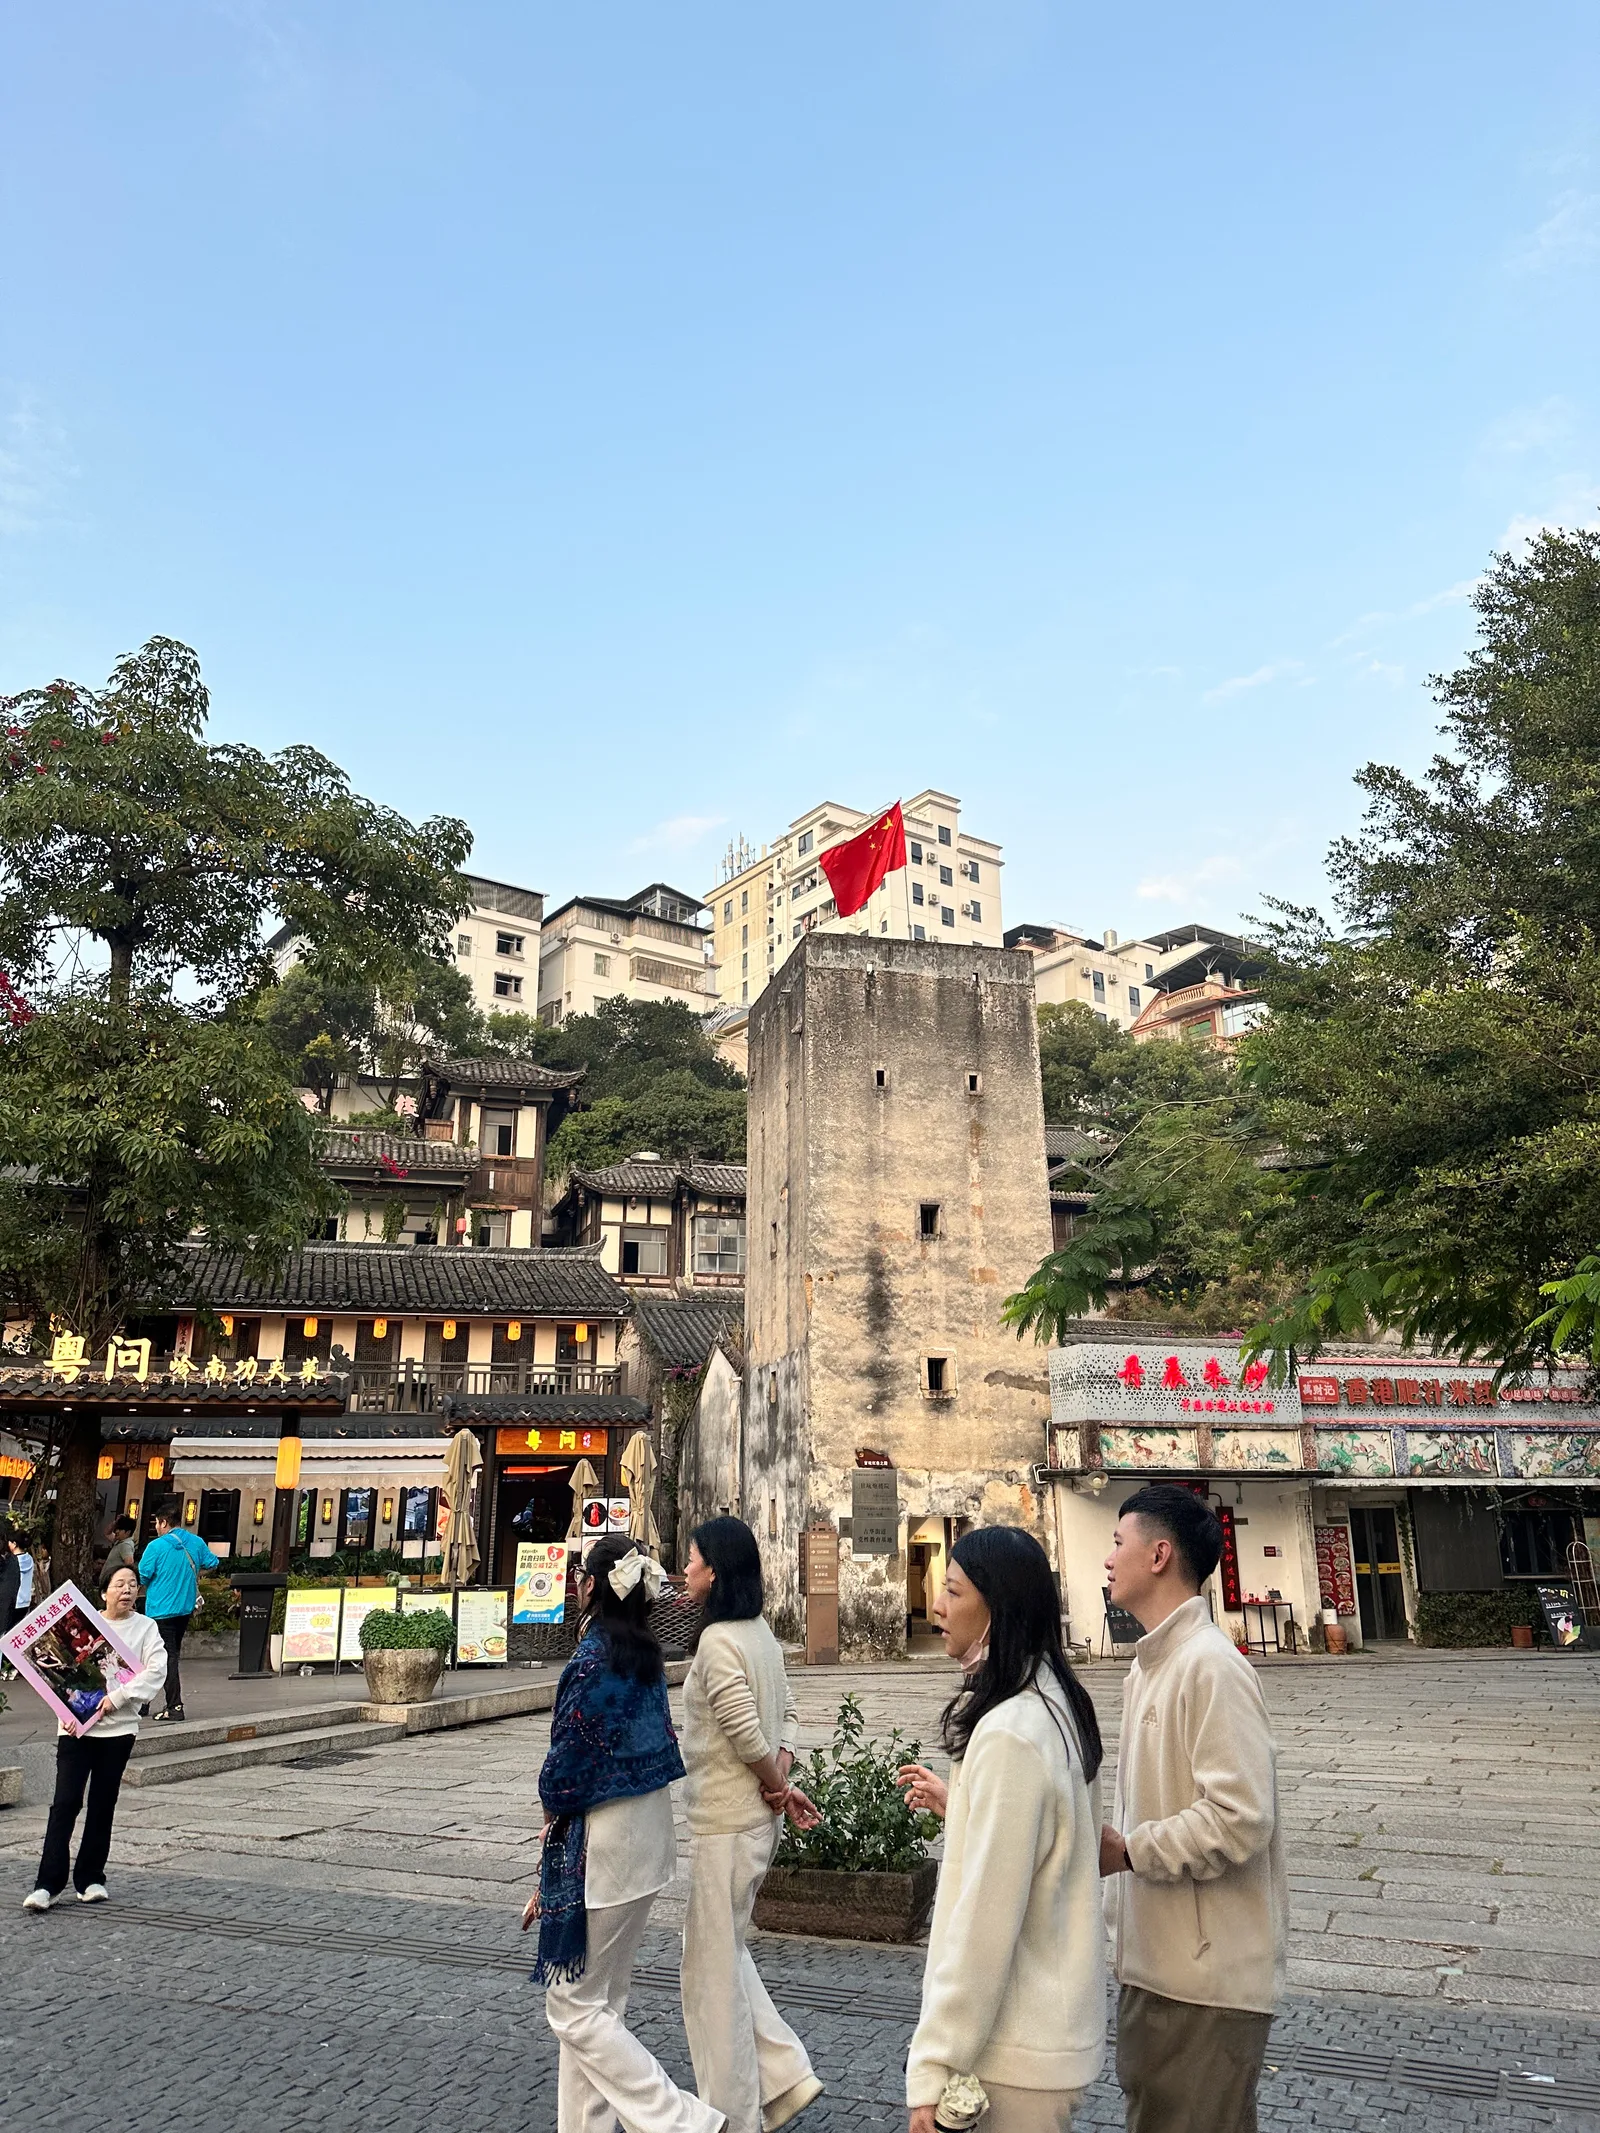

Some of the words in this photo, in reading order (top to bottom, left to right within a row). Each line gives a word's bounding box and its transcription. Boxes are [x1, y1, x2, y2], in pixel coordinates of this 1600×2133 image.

[43, 1330, 152, 1384] 粤问
[169, 1354, 324, 1383] 岭南功夫菜
[525, 1429, 576, 1451] 粤问
[10, 1592, 73, 1649] 花语妆造馆
